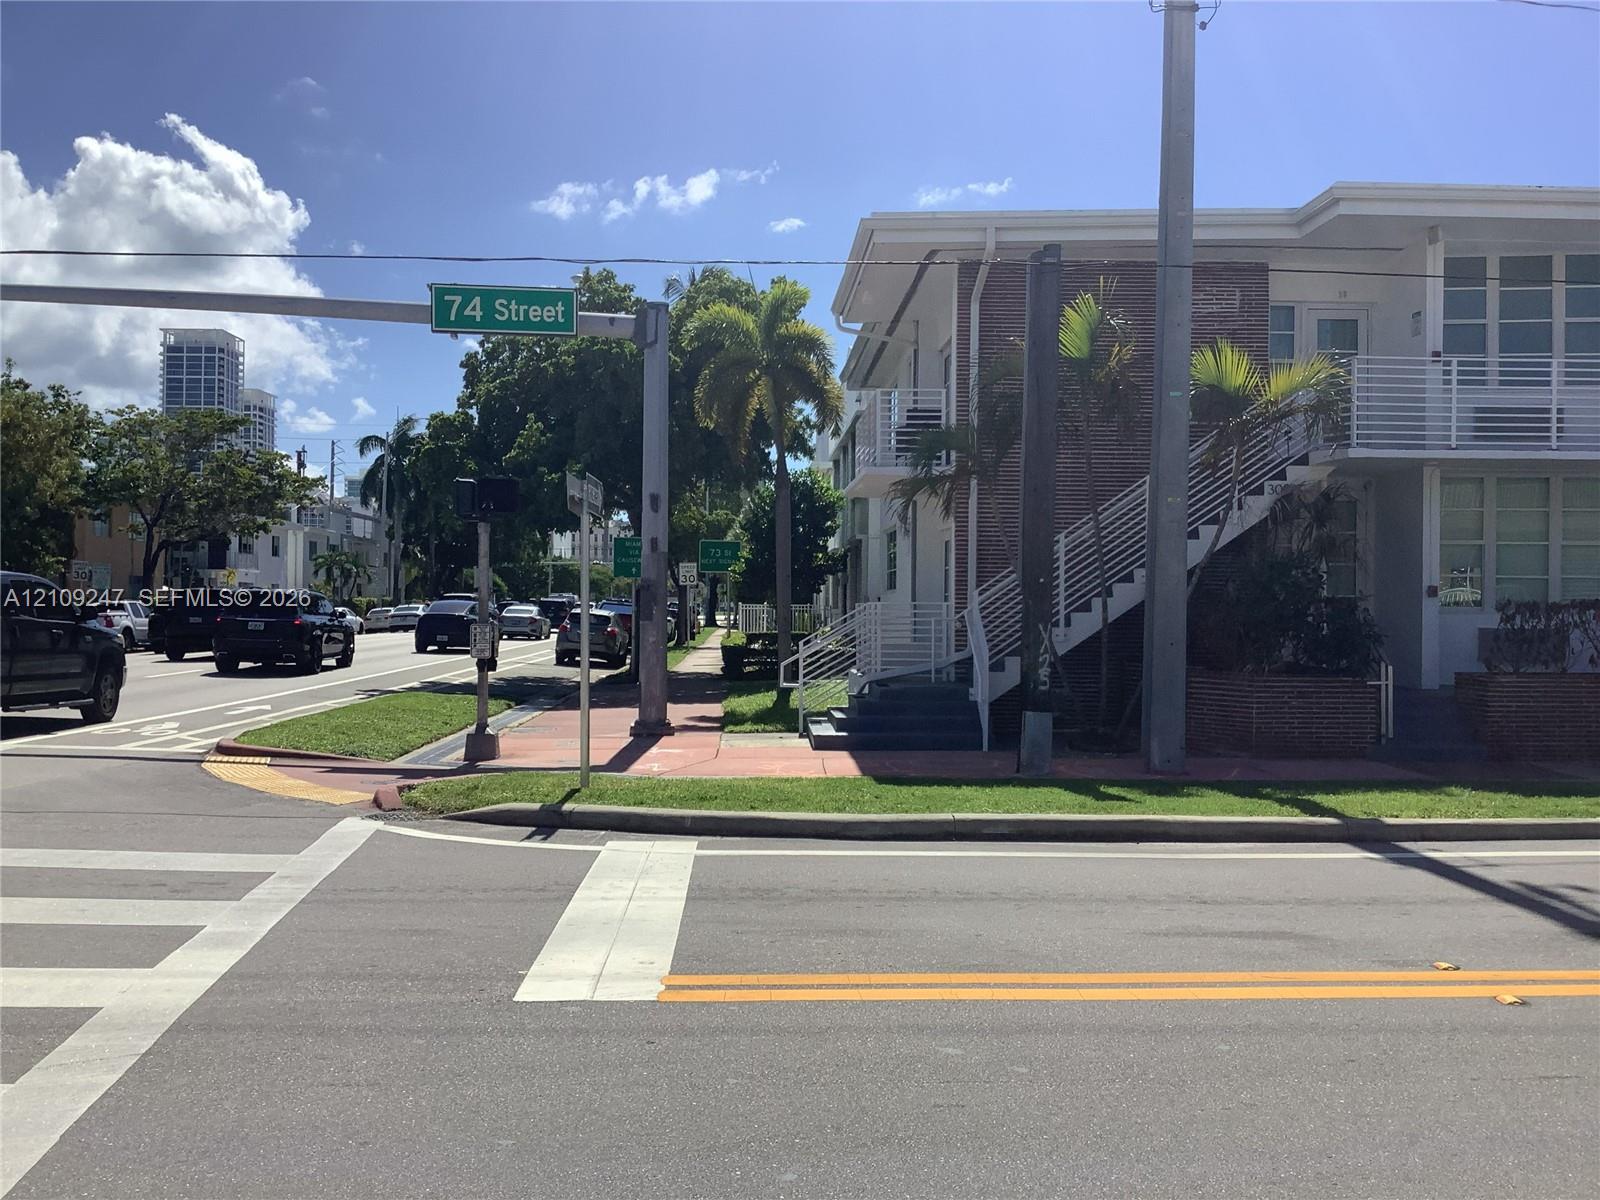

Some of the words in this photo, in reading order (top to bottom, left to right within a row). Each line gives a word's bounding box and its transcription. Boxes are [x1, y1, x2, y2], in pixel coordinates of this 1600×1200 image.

[444, 295, 483, 322] 74
[494, 298, 565, 323] Street
[708, 548, 721, 557] 73
[73, 570, 88, 580] 30
[681, 574, 696, 583] 30
